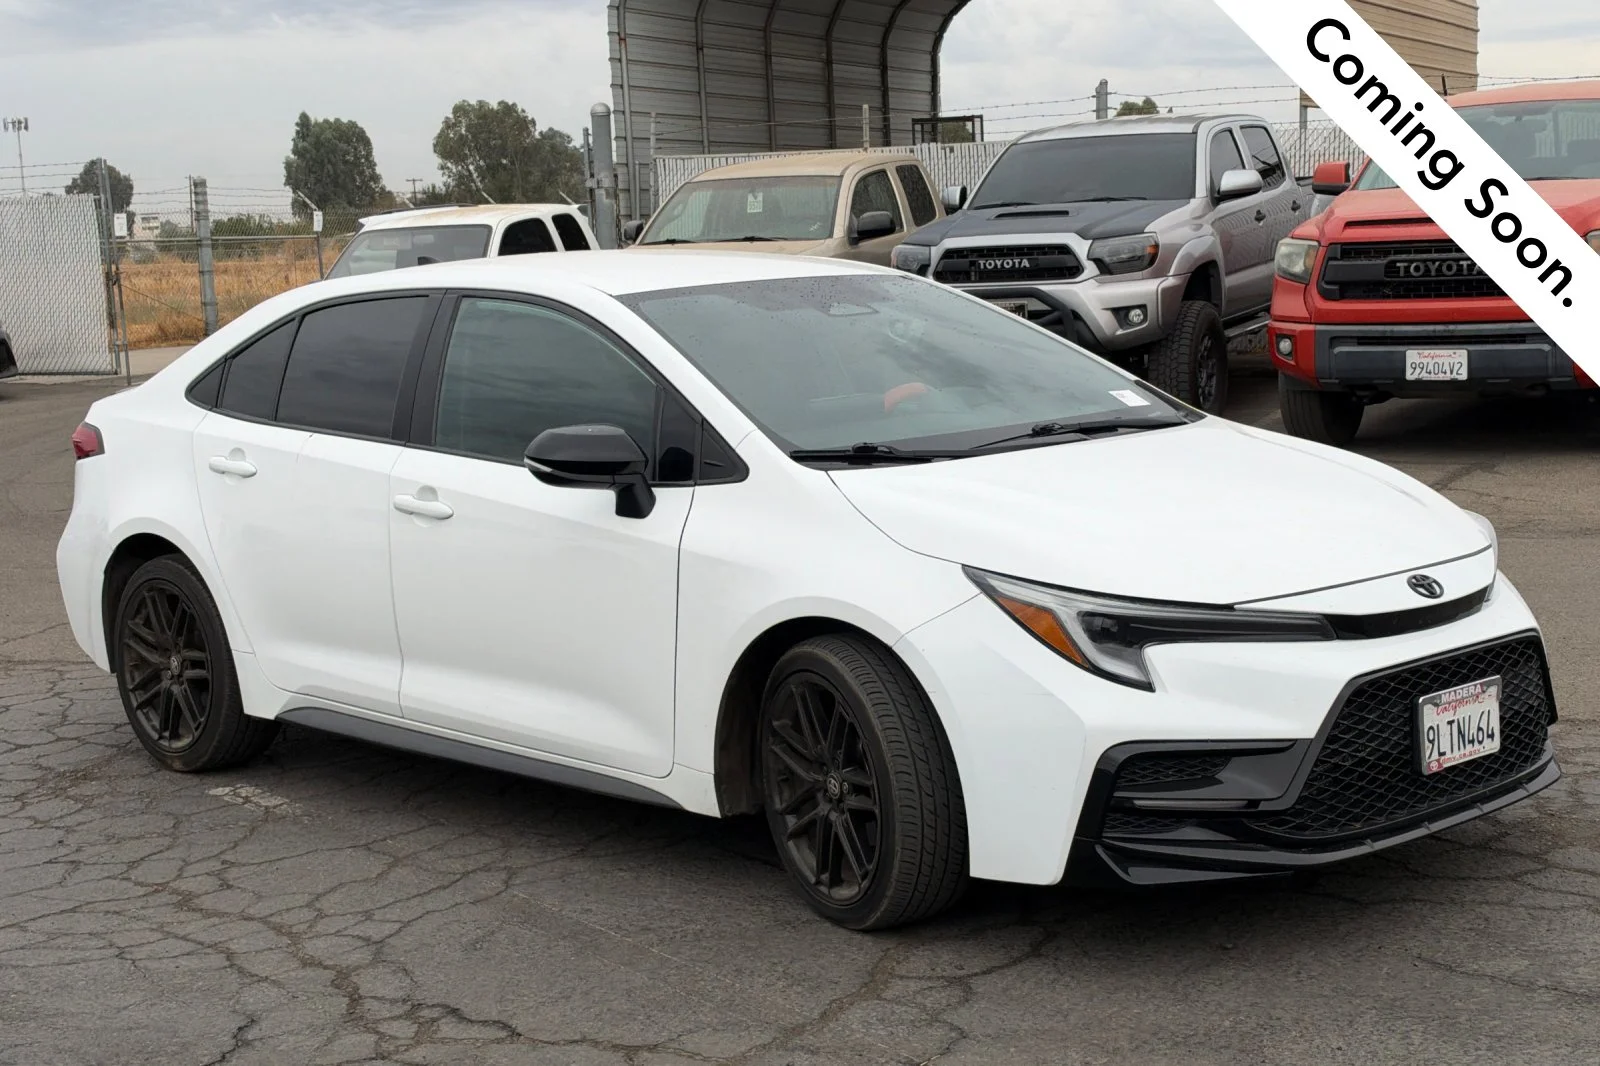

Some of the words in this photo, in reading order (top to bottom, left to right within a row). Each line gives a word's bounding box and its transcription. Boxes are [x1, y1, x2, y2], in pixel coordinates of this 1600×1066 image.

[979, 259, 1030, 269] TOYOTA
[1410, 361, 1463, 376] 99404V2
[1441, 684, 1482, 703] MADERA
[1426, 709, 1495, 760] 9LTN464
